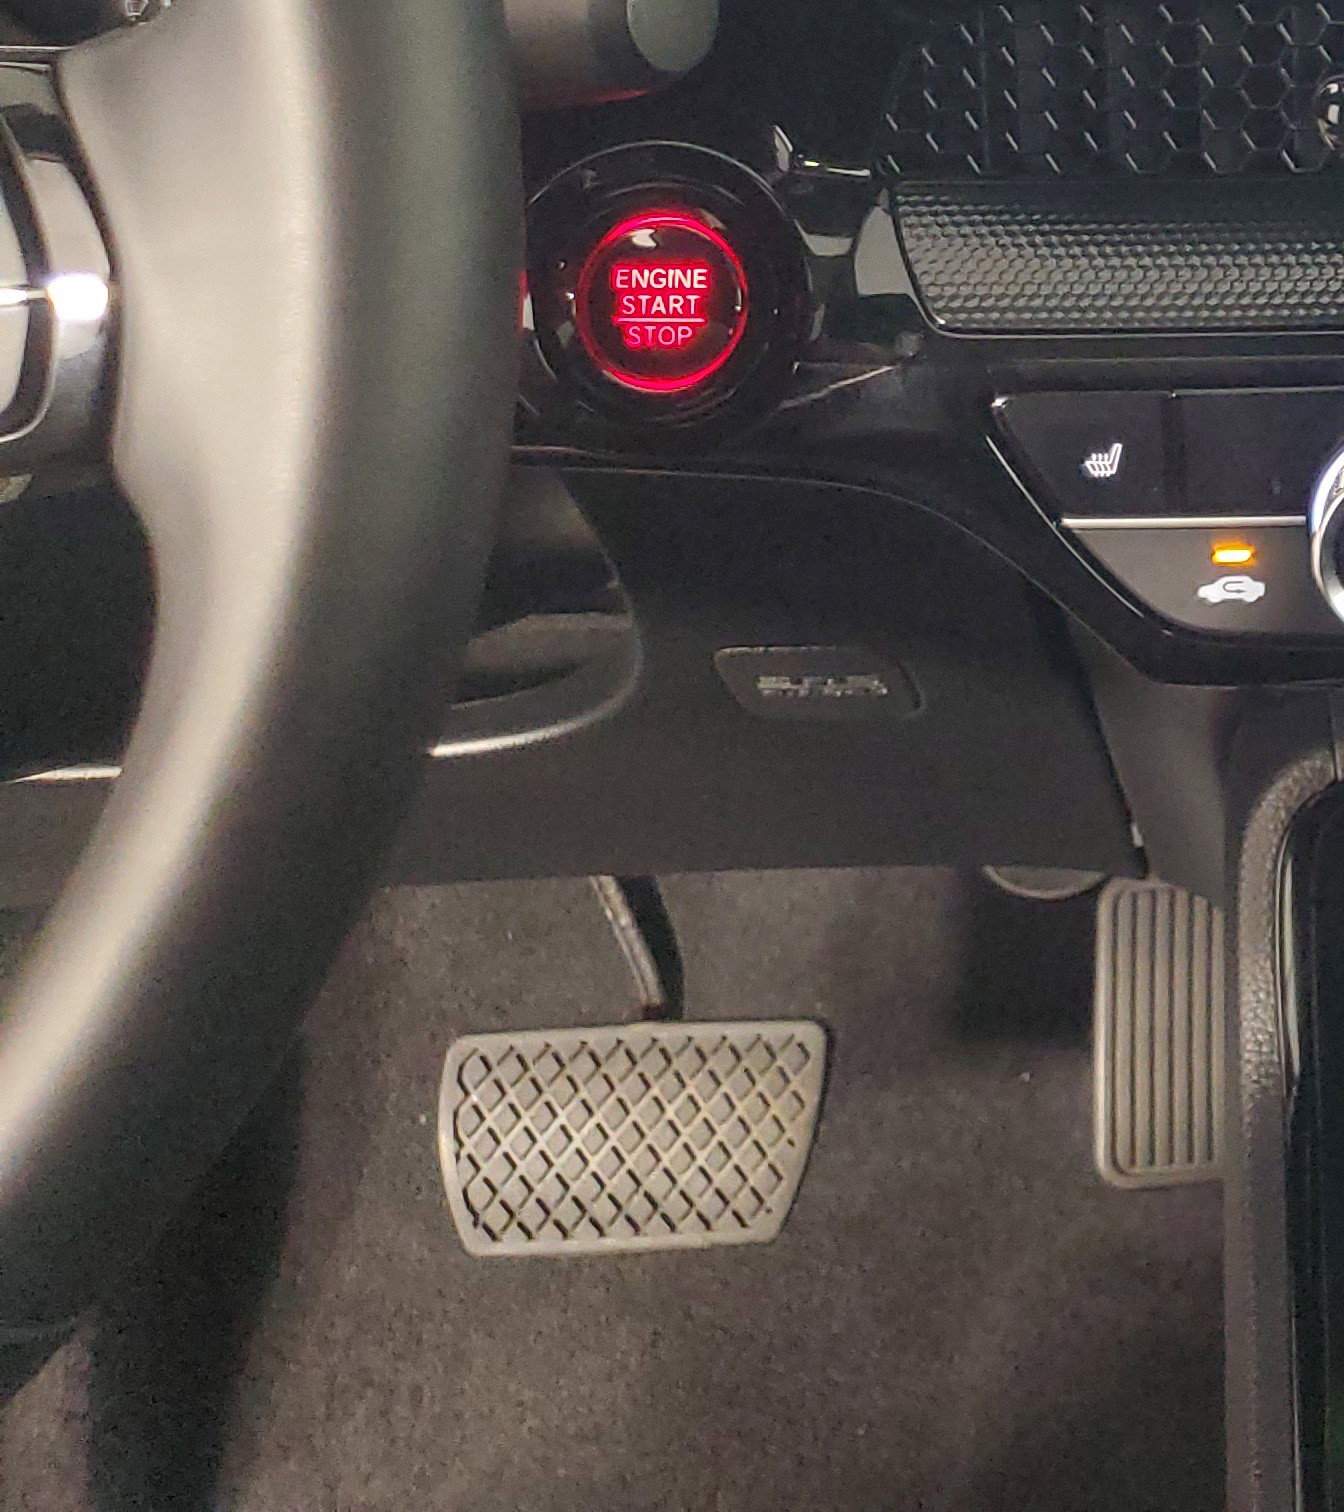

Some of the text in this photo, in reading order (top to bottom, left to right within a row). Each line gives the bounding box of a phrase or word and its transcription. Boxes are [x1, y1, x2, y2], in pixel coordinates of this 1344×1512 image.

[615, 267, 707, 290] ENGINE
[621, 294, 699, 316] START
[627, 324, 693, 346] STOP
